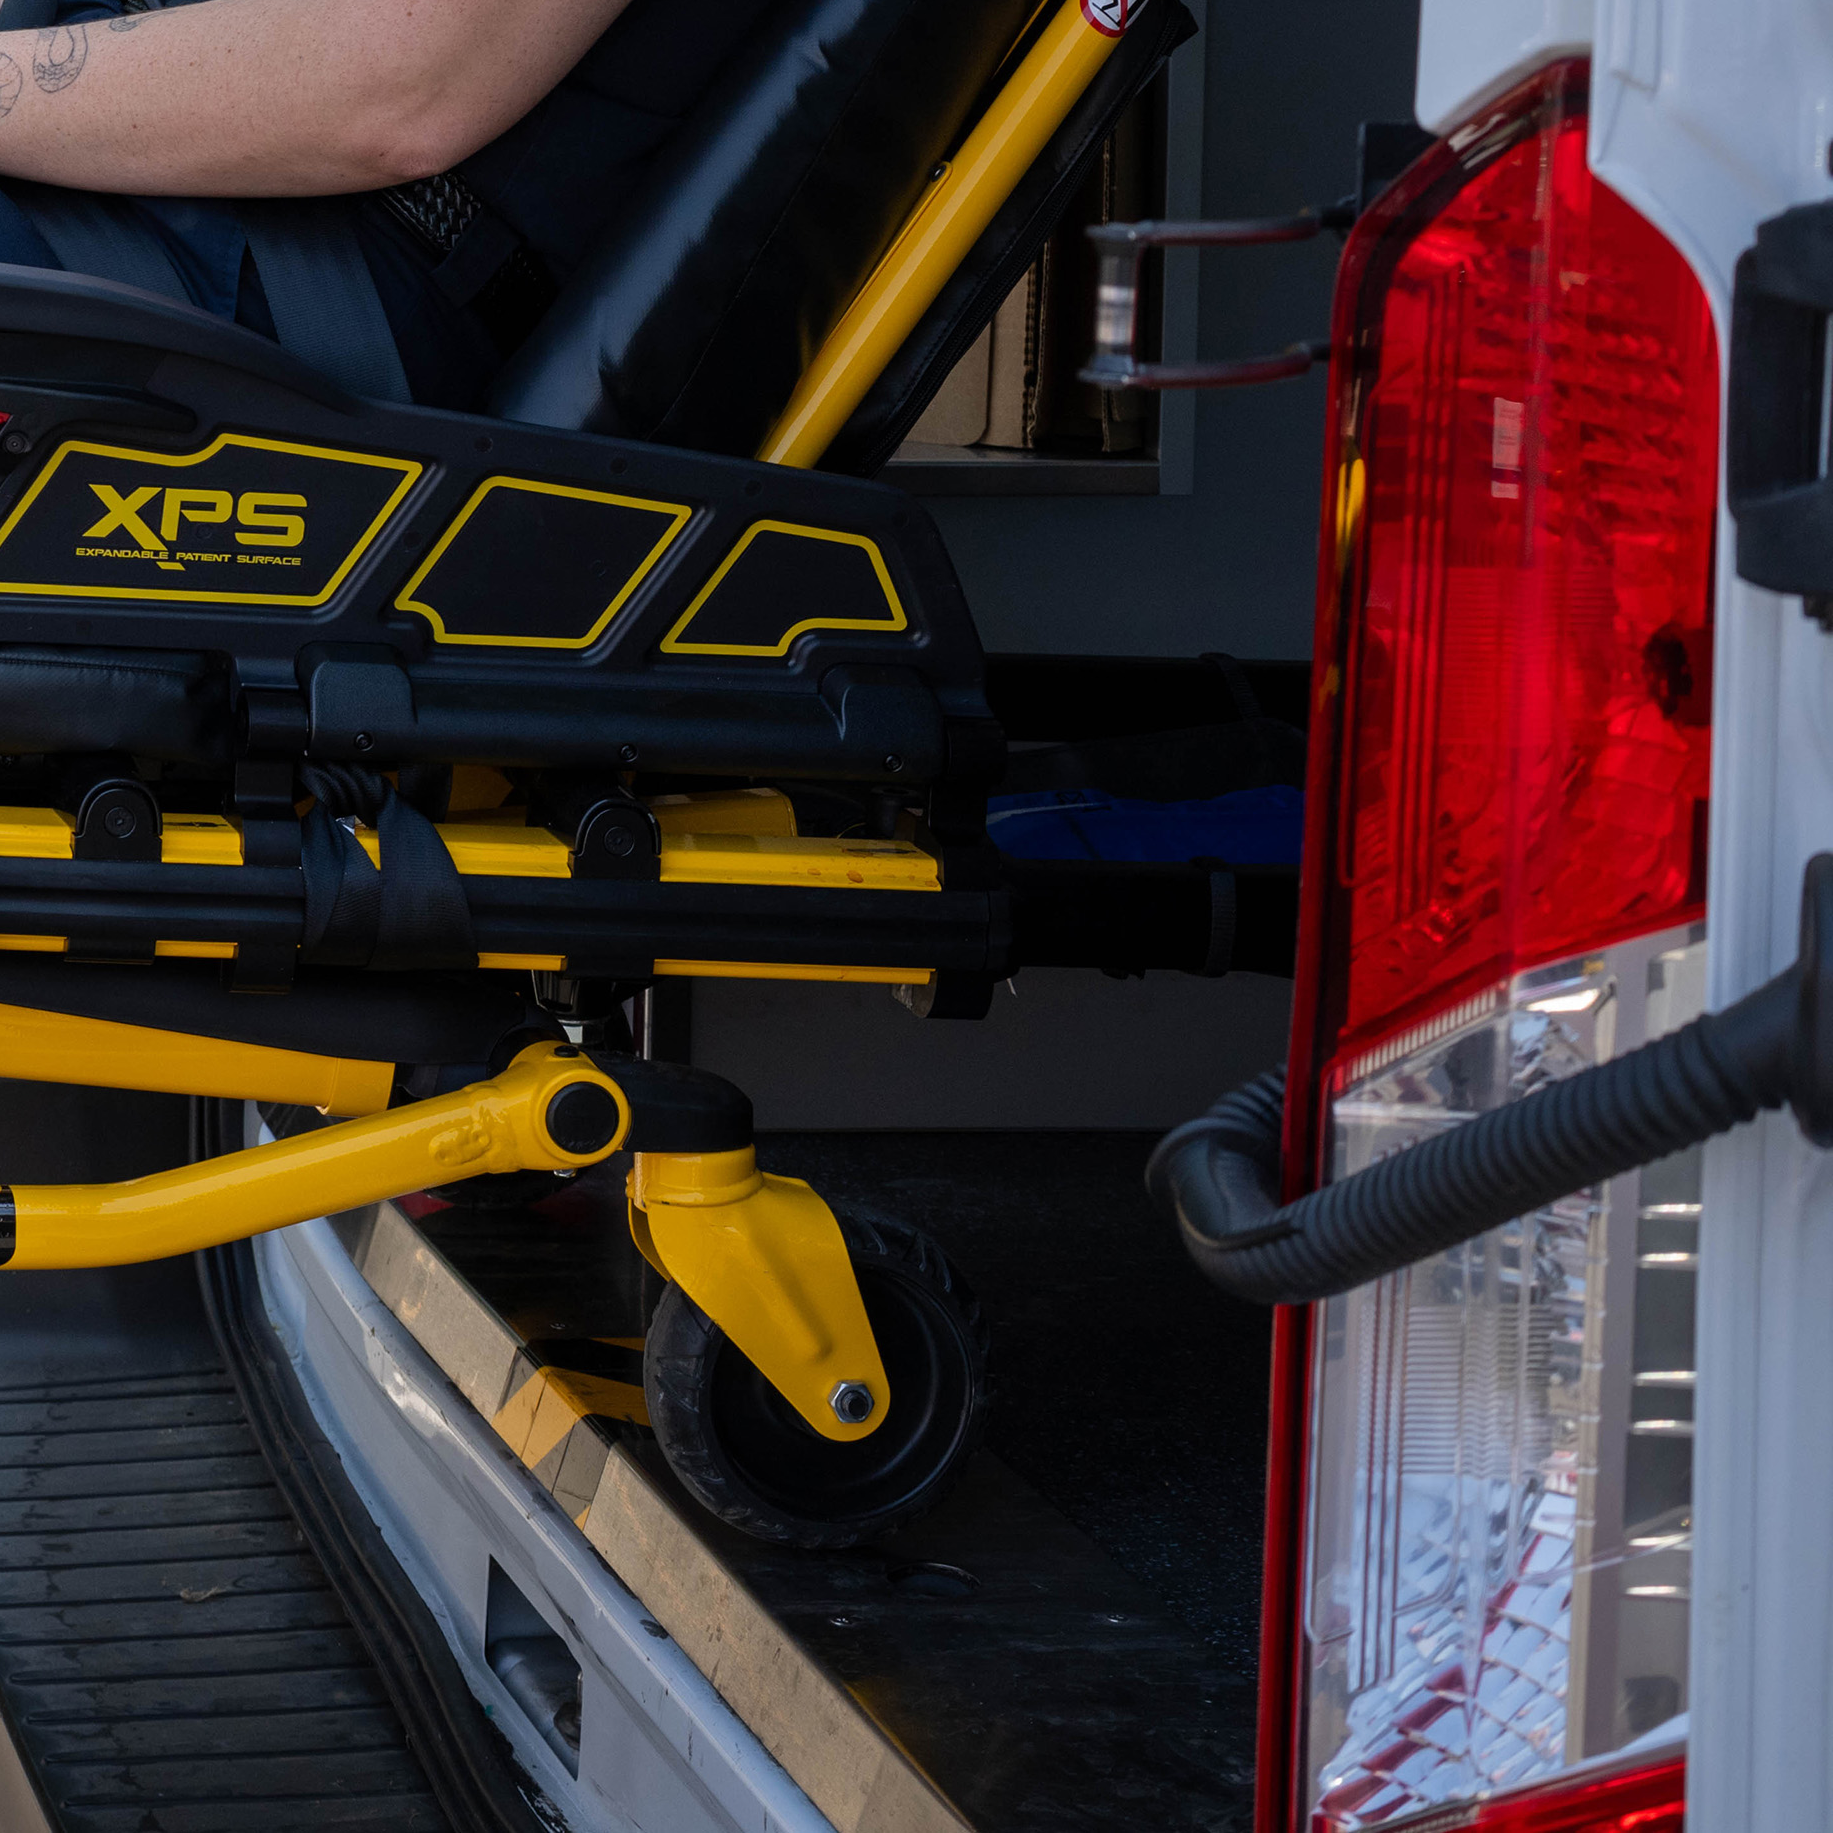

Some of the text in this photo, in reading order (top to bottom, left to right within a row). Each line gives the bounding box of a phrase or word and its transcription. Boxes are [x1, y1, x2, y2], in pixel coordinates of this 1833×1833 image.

[83, 484, 307, 552] XPS
[76, 548, 302, 566] EXPANDABLE PATIENT SURFACE
